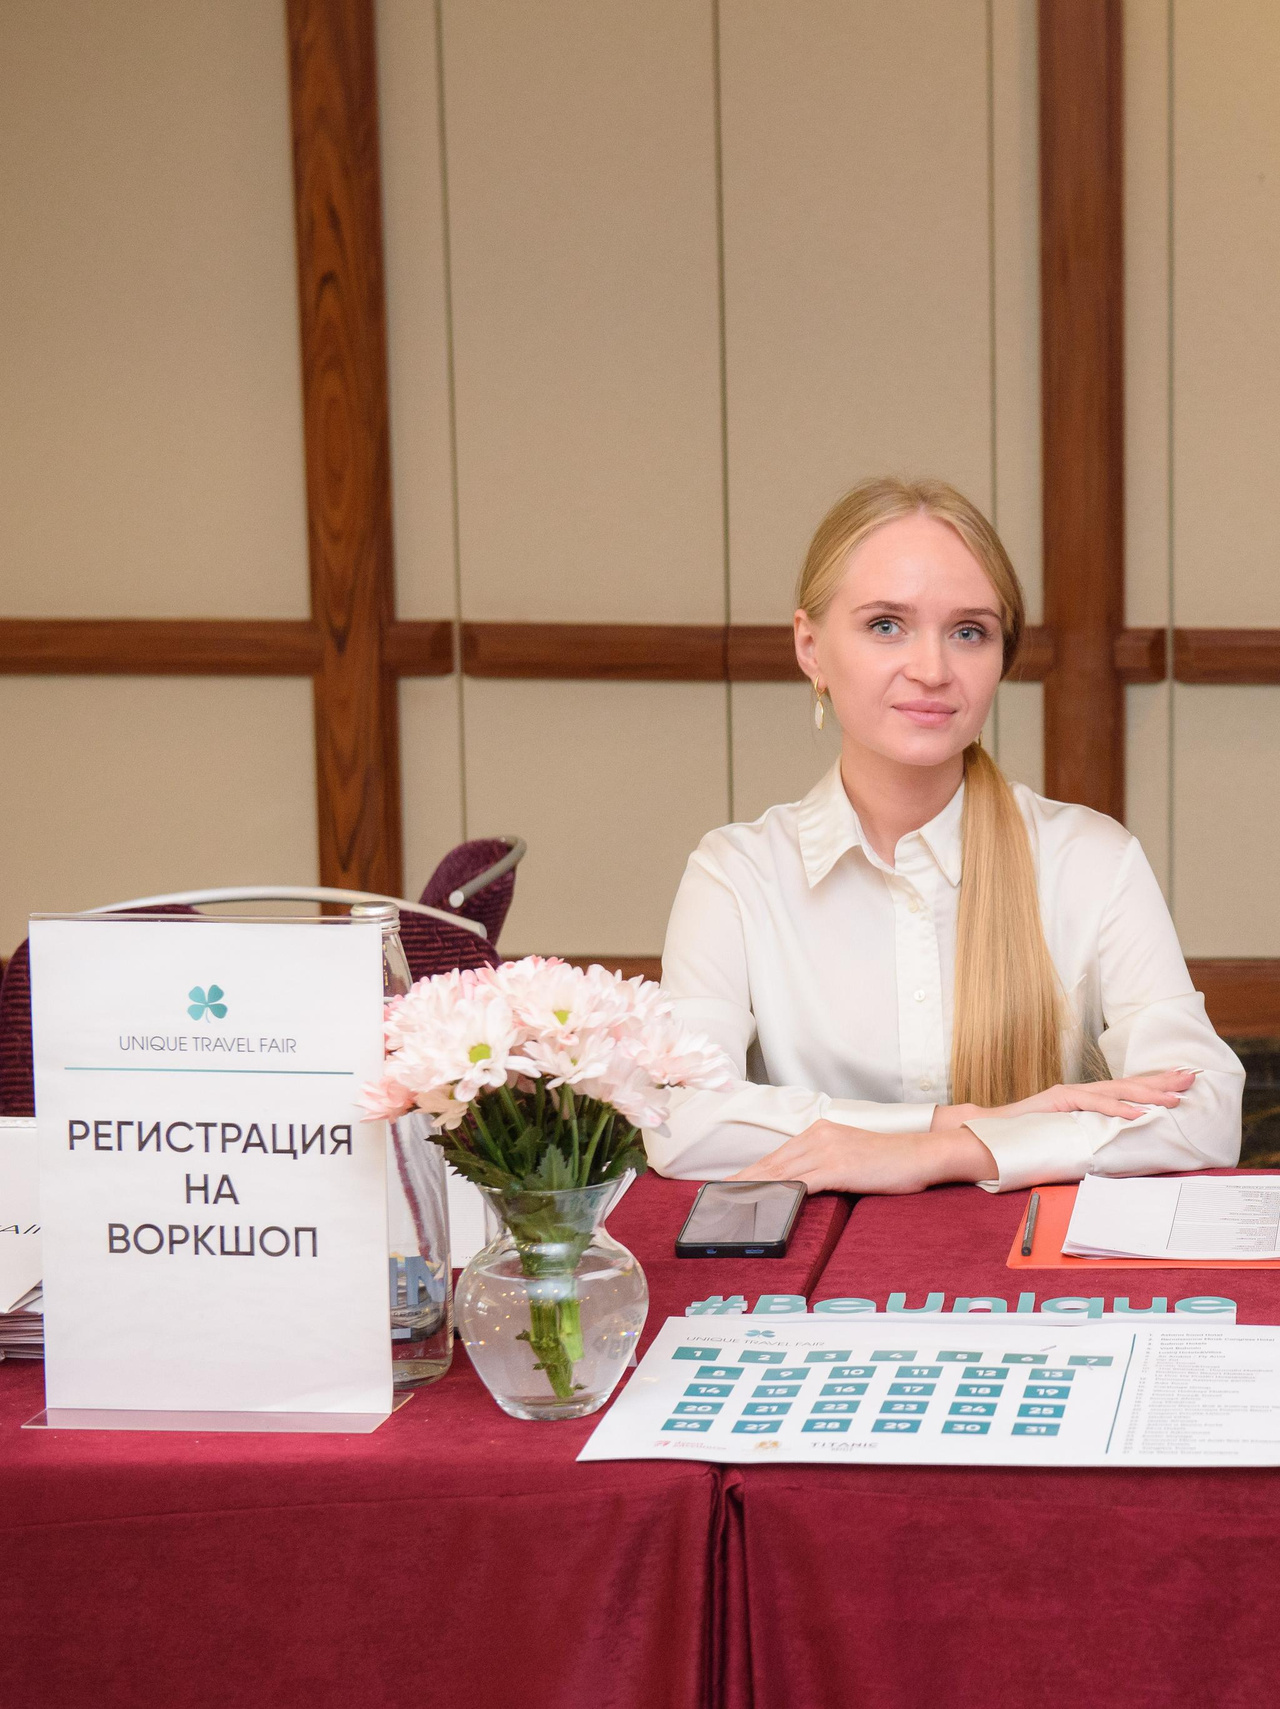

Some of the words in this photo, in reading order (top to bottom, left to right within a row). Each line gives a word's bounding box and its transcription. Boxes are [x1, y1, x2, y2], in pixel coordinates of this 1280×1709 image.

[119, 1035, 188, 1052] UNIQUE
[192, 1036, 255, 1053] TRAVEL
[259, 1037, 297, 1053] FAIR
[68, 1119, 354, 1160] РЕГИСТРАЦИЯ
[185, 1173, 240, 1205] НА
[107, 1223, 318, 1258] ВОРКШОП
[685, 1292, 1238, 1319] #BeUnique
[686, 1336, 740, 1344] UNIQUE
[744, 1339, 789, 1347] TRAVEL
[824, 1352, 837, 1360] 3
[1037, 1388, 1059, 1396] 19
[755, 1405, 778, 1413] 21
[959, 1405, 986, 1413] 24
[1028, 1407, 1054, 1415] 25
[673, 1421, 700, 1429] 26
[744, 1423, 771, 1431] 27
[812, 1421, 841, 1429] 28
[883, 1422, 911, 1430] 29
[952, 1424, 981, 1432] 30
